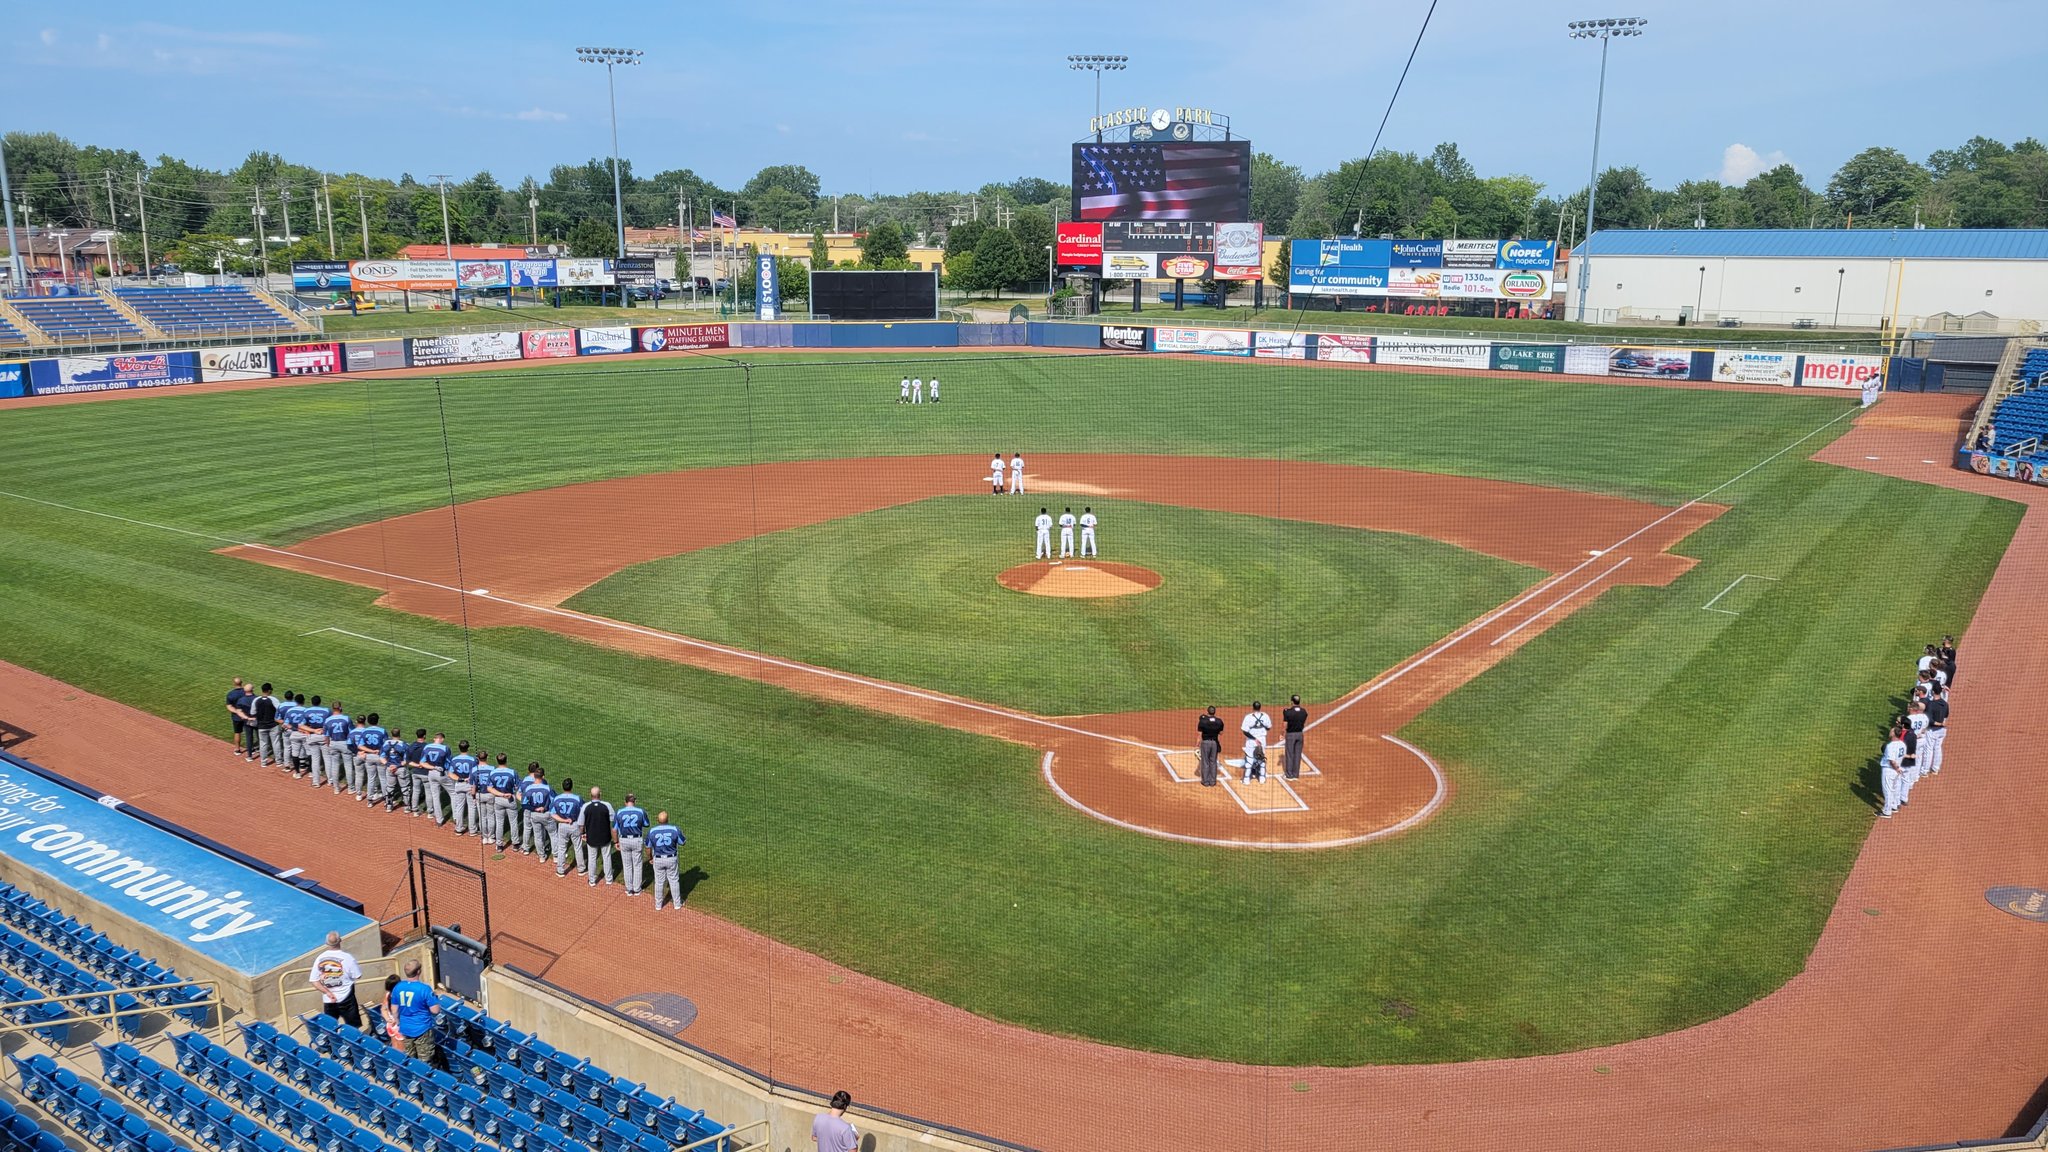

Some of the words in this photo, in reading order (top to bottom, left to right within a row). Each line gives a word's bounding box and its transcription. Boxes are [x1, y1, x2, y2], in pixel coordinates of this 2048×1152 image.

[1090, 107, 1147, 132] CLASSIC
[1176, 107, 1212, 125] PARK
[1058, 233, 1102, 244] Cardinal
[1341, 243, 1363, 252] Health
[1399, 244, 1416, 254] John
[1416, 244, 1441, 253] Carroll
[1509, 249, 1543, 257] NOPEC
[1217, 249, 1258, 259] Budweiser
[512, 261, 552, 269] Playground
[1515, 258, 1550, 266] nopec.org
[357, 266, 398, 276] JONES
[1294, 267, 1315, 276] Caring
[761, 258, 772, 303] $1,000!
[1328, 275, 1383, 287] community
[1506, 280, 1541, 288] ORLANDO
[586, 330, 626, 342] Lakeland
[668, 327, 703, 337] MINUTE
[705, 326, 724, 335] MEN
[1102, 326, 1144, 340] Mentor
[412, 338, 459, 348] American
[668, 336, 697, 344] STAFFING
[286, 344, 309, 353] 970
[312, 343, 330, 352] AM
[412, 346, 459, 356] Fireworks
[1381, 341, 1402, 352] THE
[1405, 342, 1487, 356] NEWS-HERALD
[1512, 350, 1534, 358] LAKE
[284, 351, 334, 368] ESPN
[1744, 354, 1783, 362] BAKER
[218, 352, 250, 377] Gold
[1804, 359, 1880, 385] meijer
[37, 380, 129, 395] wardslawncare.com
[137, 376, 194, 388] 440-942-1912
[308, 712, 324, 724] 35
[332, 722, 343, 734] 21
[1913, 720, 1922, 731] 39
[365, 733, 379, 746] 36
[428, 751, 440, 762] 17
[455, 762, 470, 774] 30
[494, 775, 509, 788] 27
[531, 791, 544, 804] 10
[24, 795, 66, 814] for
[558, 801, 574, 814] 37
[622, 813, 639, 827] 22
[655, 833, 672, 847] 25
[16, 823, 274, 943] community
[399, 990, 414, 1007] 17
[626, 1008, 681, 1028] NOPEC
